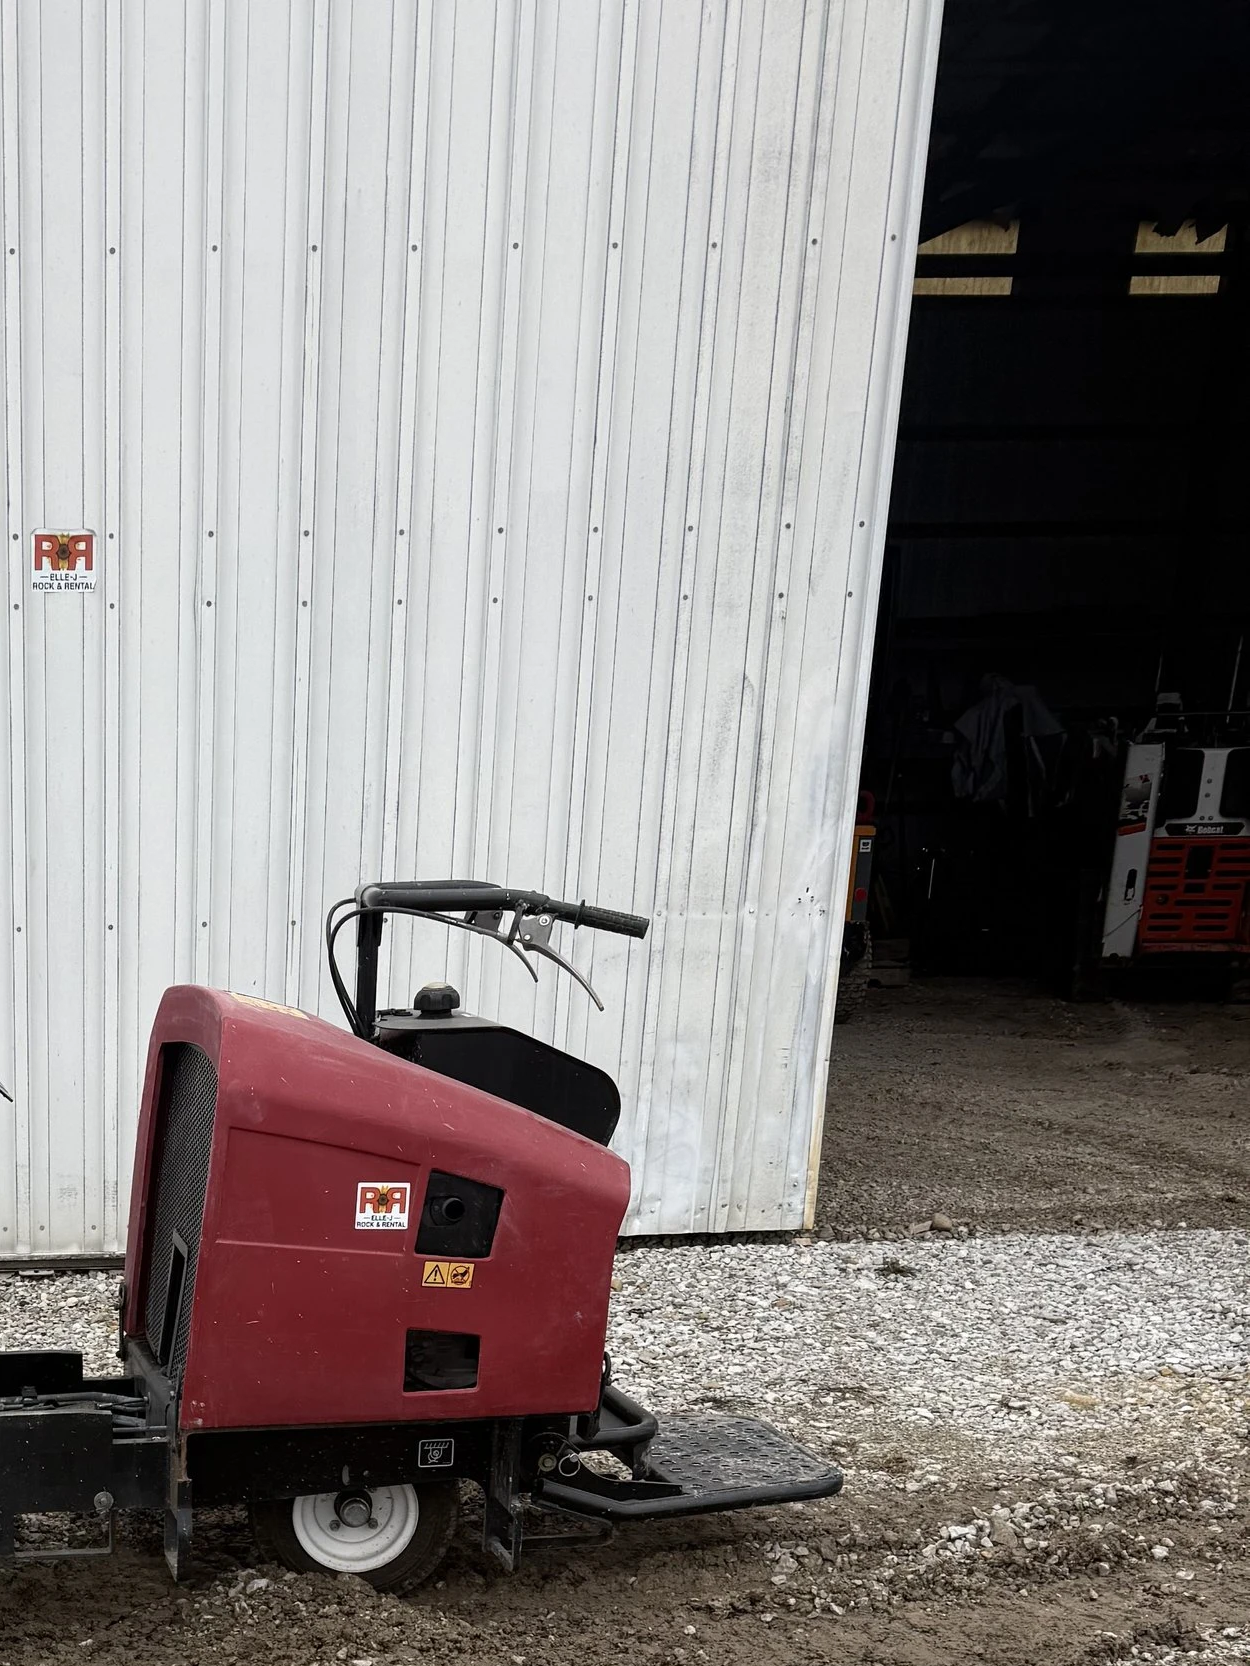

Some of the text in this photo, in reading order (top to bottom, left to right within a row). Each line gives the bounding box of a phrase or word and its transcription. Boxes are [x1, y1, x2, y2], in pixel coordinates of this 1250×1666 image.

[49, 573, 78, 582] ELLE-J
[32, 582, 95, 591] ROCK & RENTAL
[370, 1214, 393, 1222] ELLE-J
